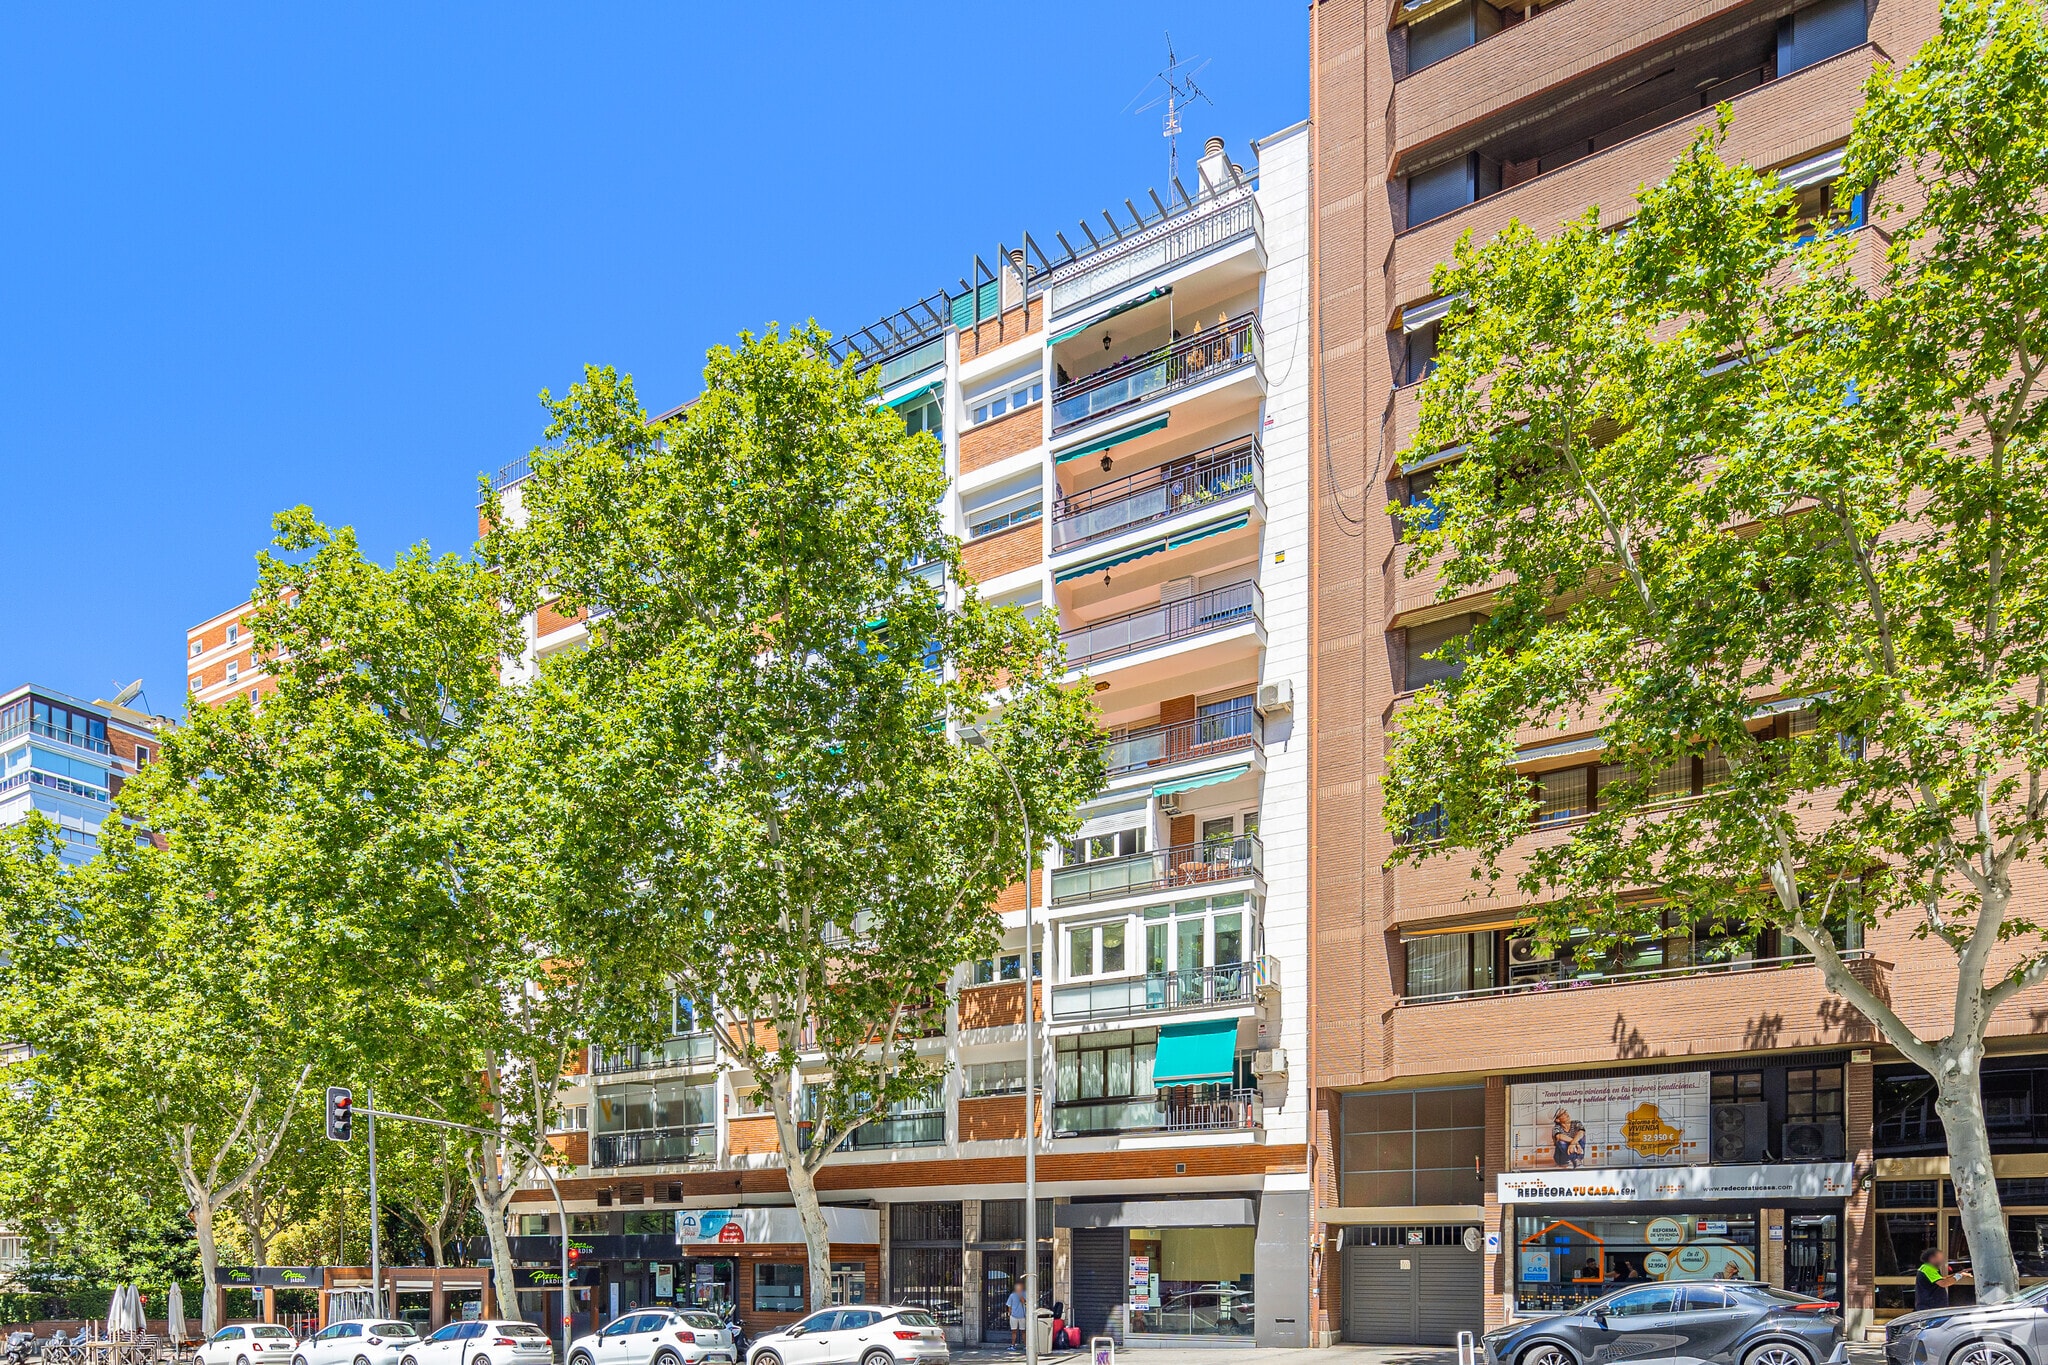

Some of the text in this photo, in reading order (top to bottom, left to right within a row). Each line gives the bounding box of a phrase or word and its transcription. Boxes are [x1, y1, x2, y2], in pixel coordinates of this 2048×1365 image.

[1612, 1086, 1620, 1094] en
[1621, 1085, 1631, 1093] las
[1632, 1083, 1657, 1094] mejores
[1628, 1124, 1660, 1132] VIVIENDA
[1642, 1133, 1674, 1142] 32.950 €
[1703, 1184, 1793, 1192] www.redecoratucasa.com
